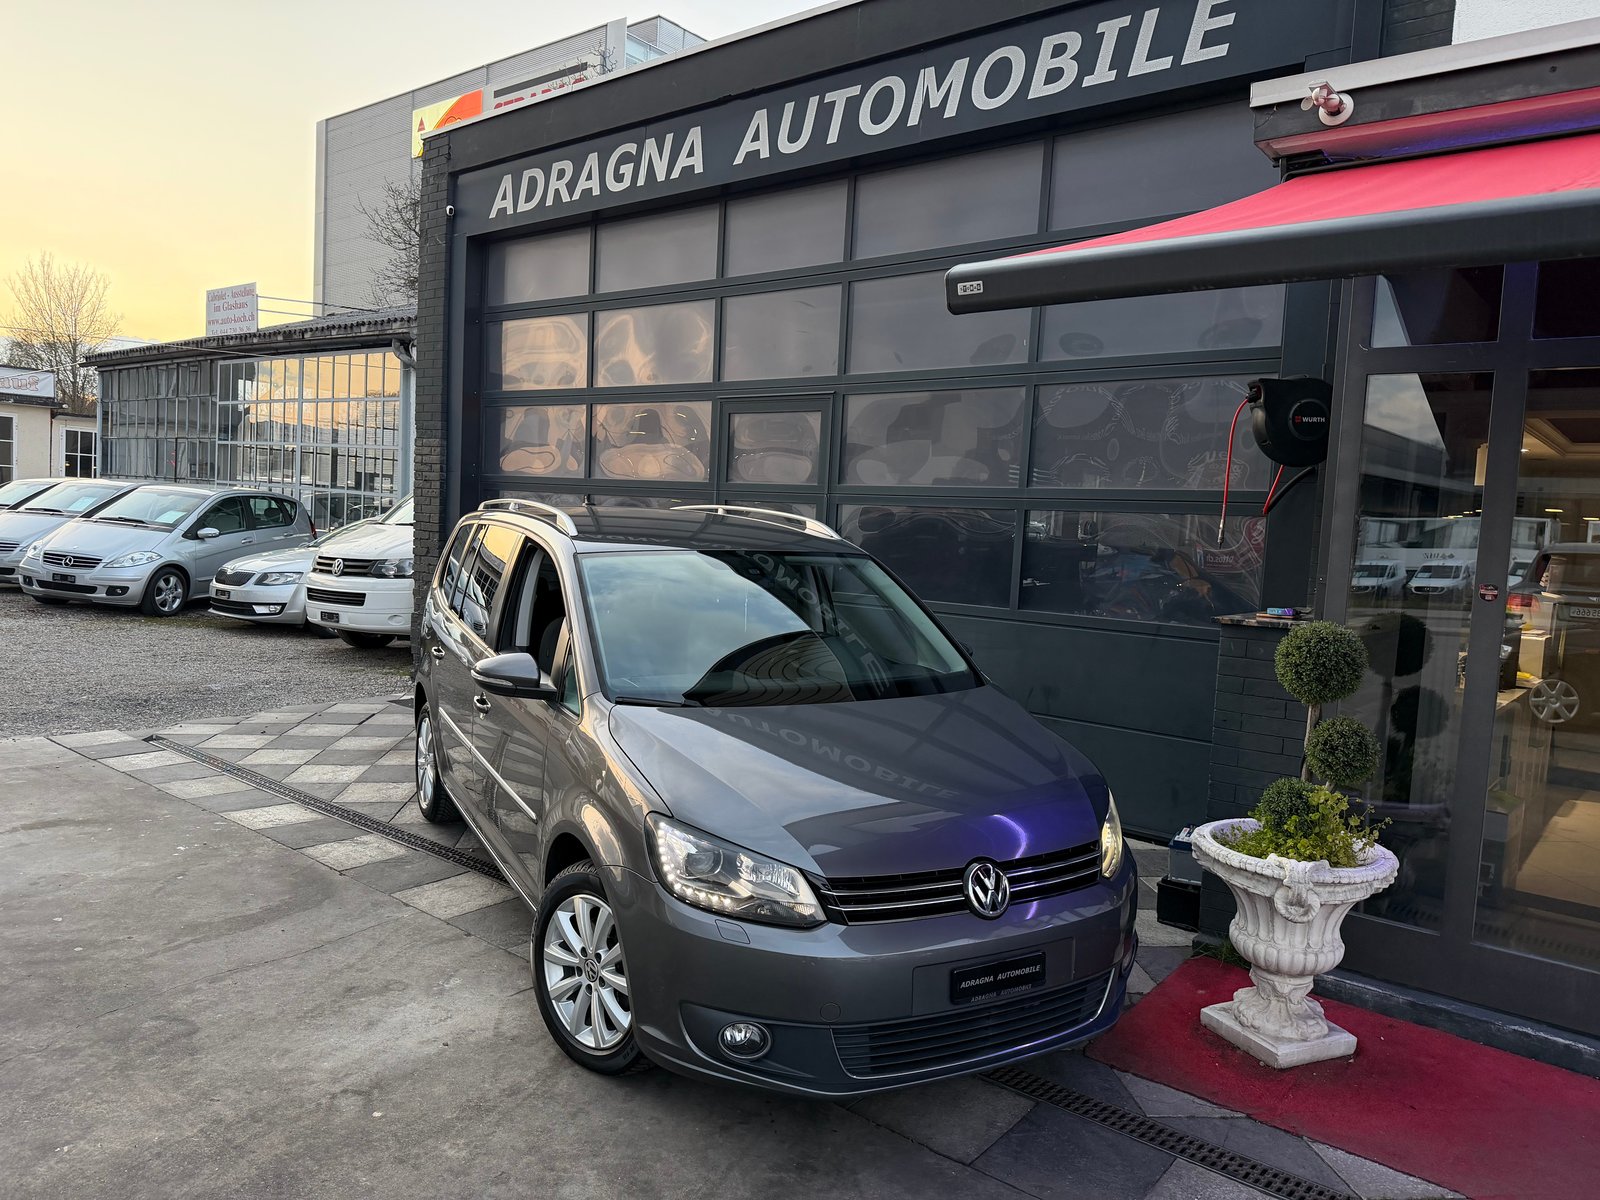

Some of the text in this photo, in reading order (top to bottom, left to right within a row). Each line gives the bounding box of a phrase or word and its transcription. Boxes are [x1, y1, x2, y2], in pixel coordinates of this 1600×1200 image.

[489, 0, 1237, 219] ADRAGNA AUTOMOBILE
[213, 300, 249, 313] im Glashaus
[207, 311, 255, 326] www.auto-koch.ch
[960, 964, 1041, 989] ADRAGNA AUTOMOBILE
